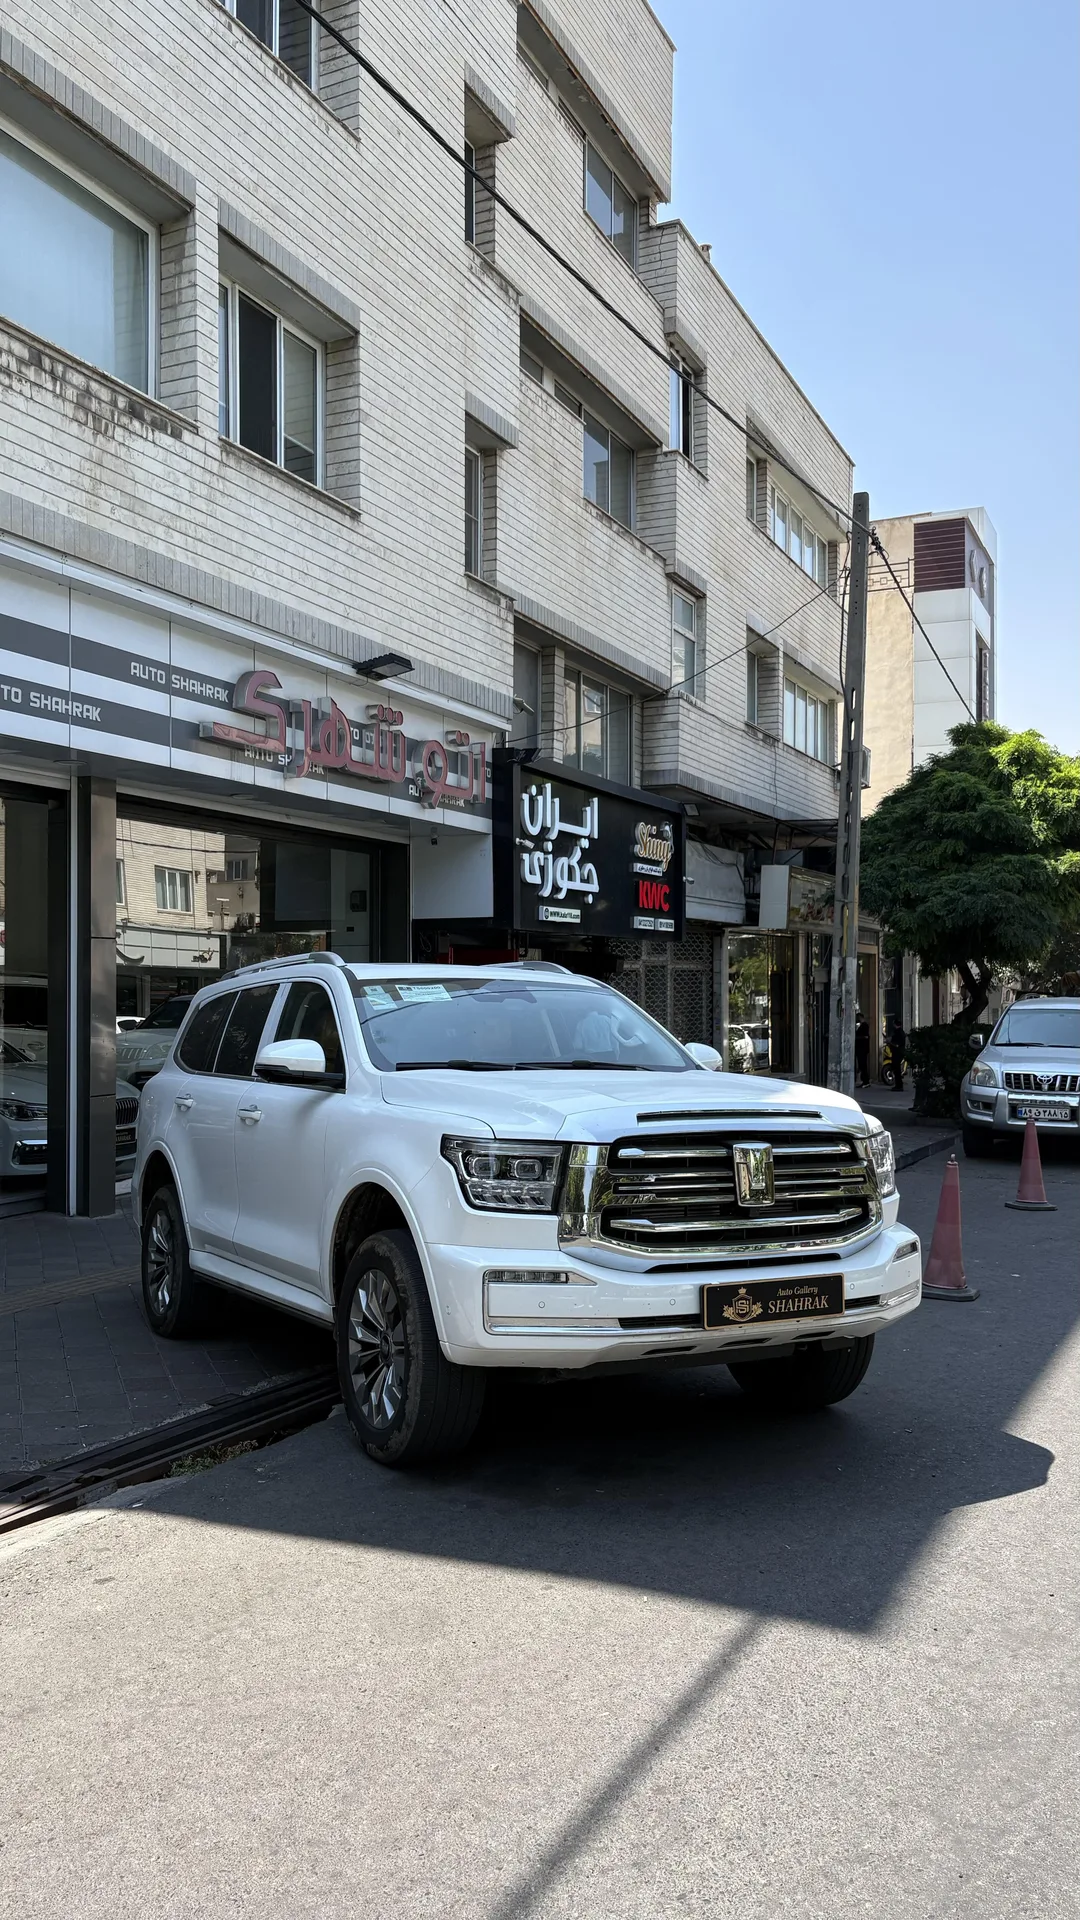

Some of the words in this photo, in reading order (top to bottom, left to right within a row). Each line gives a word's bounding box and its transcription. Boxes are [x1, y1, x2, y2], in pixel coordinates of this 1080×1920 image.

[130, 661, 166, 685] AUTO
[171, 674, 229, 704] SHAHRAK
[0, 684, 22, 704] TO
[29, 691, 102, 722] SHAHRAK
[520, 782, 598, 849] ایران
[520, 841, 600, 905] جکوزی
[638, 879, 671, 912] KWC
[768, 1295, 829, 1314] SHAHRAK
[777, 1287, 793, 1296] Auto
[794, 1285, 819, 1295] Gallery
